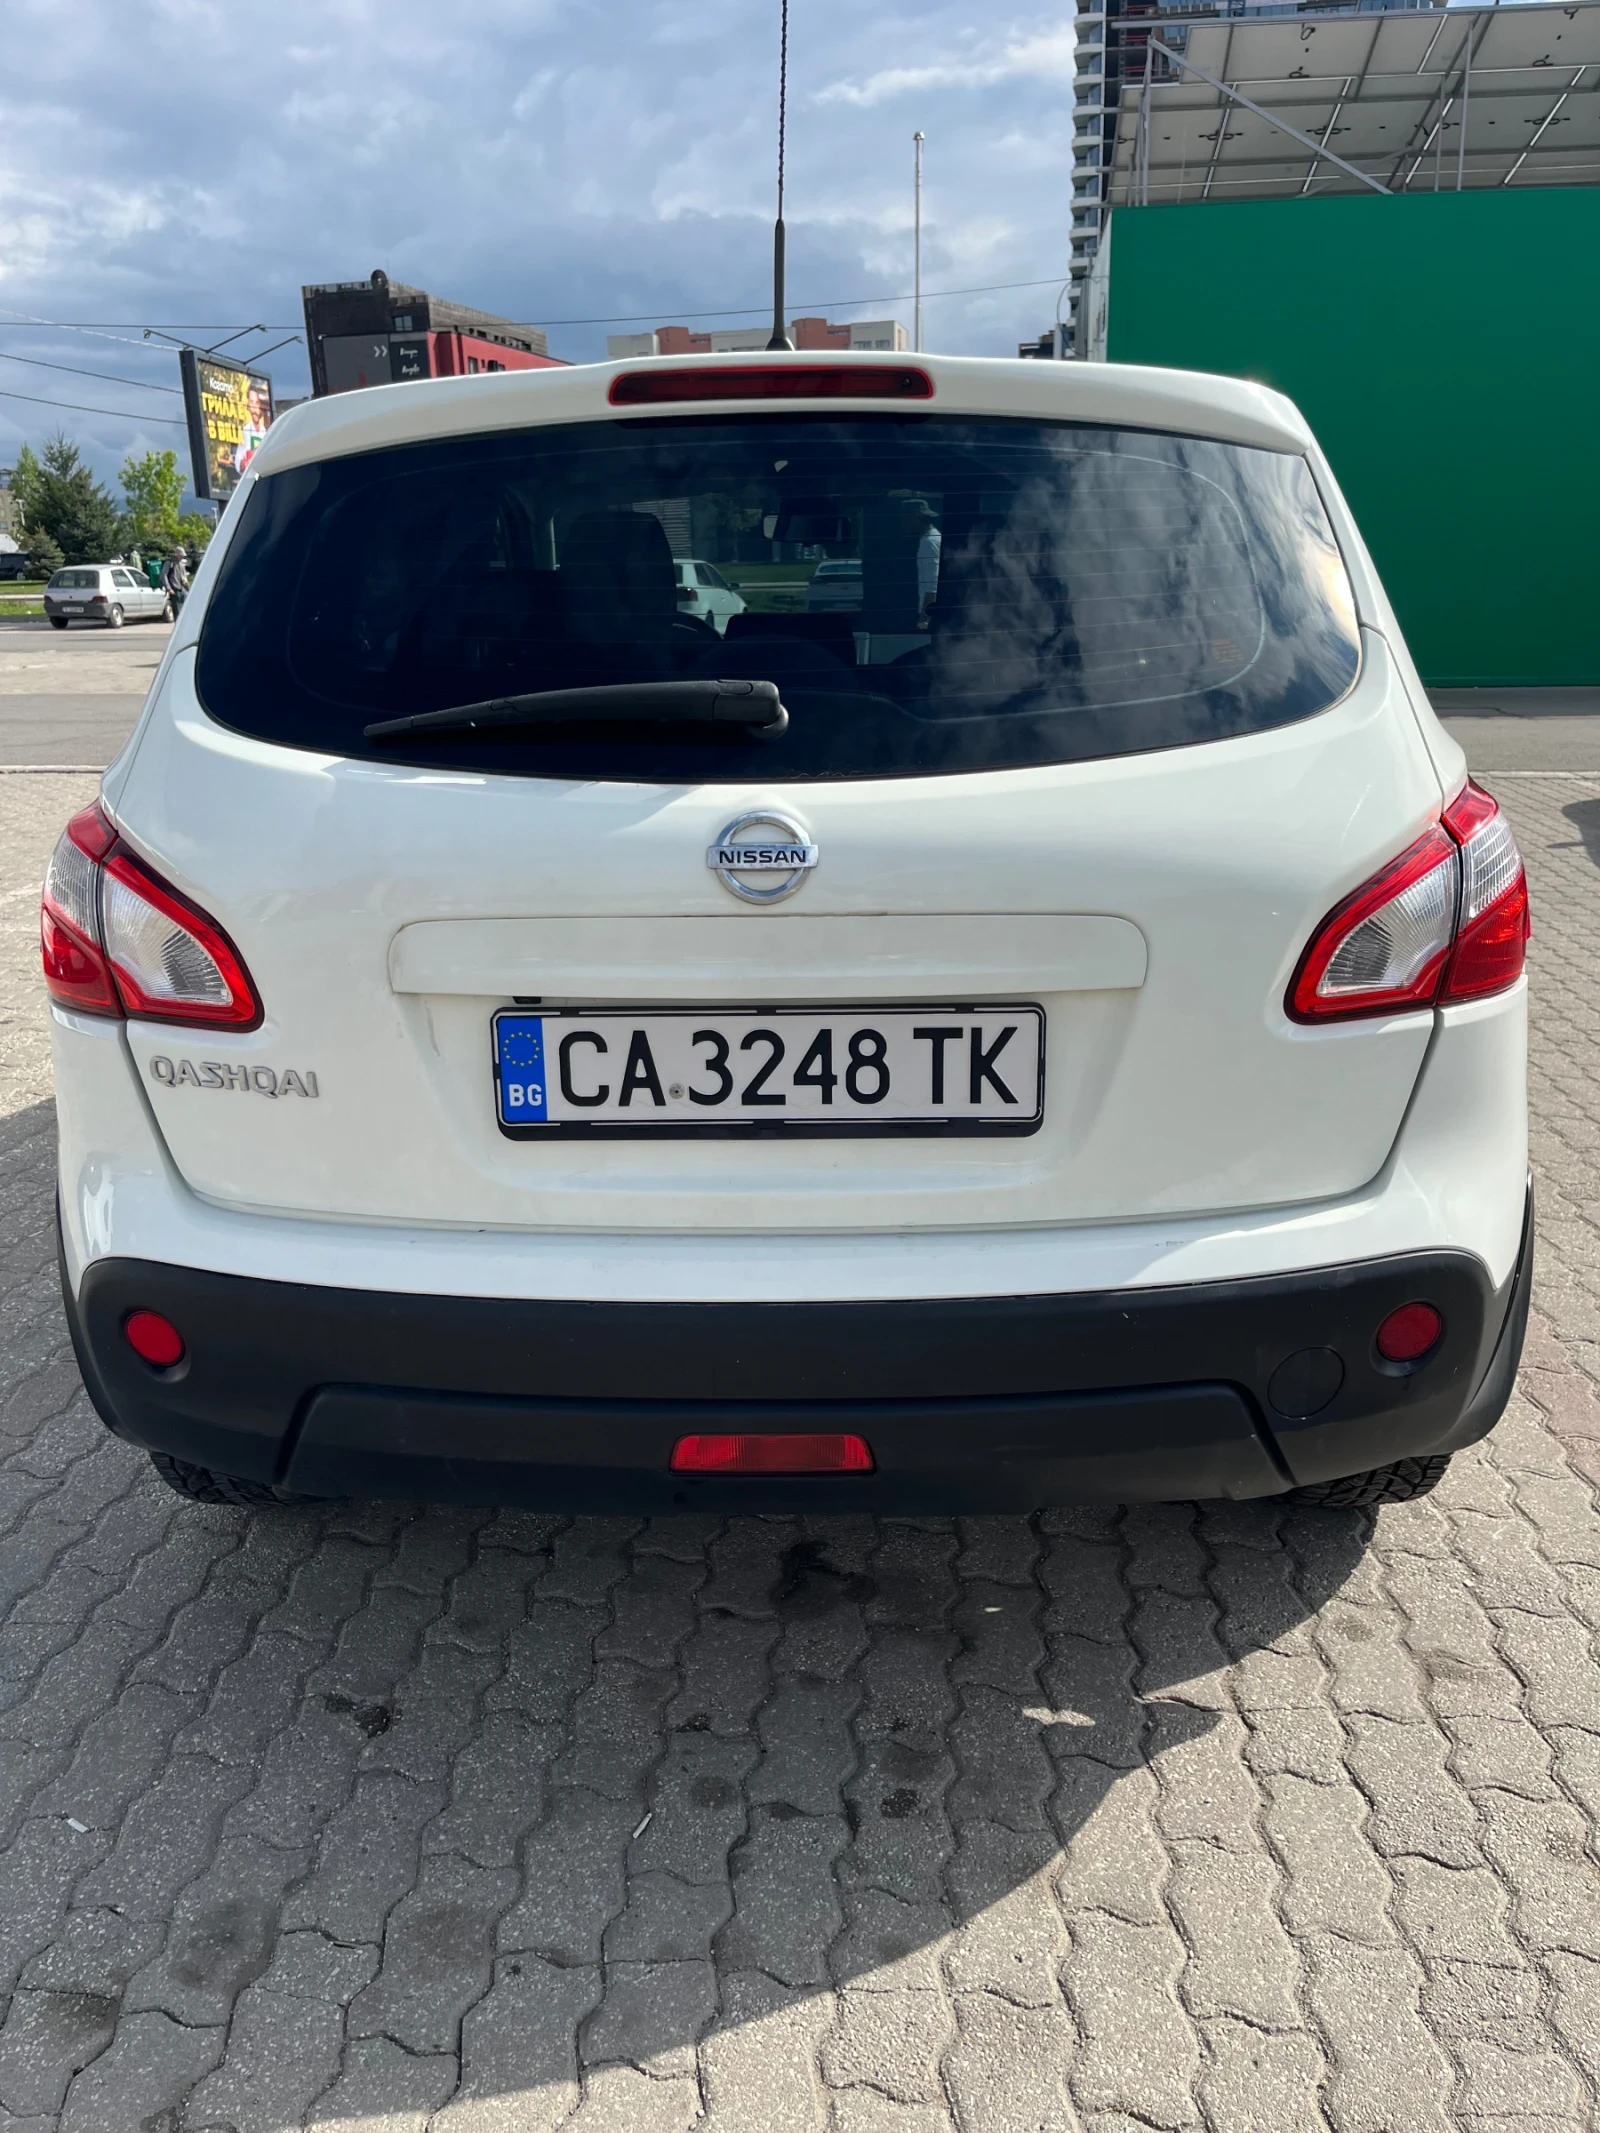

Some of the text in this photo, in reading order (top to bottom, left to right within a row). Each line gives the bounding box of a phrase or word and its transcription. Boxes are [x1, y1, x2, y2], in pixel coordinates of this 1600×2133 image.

[217, 420, 244, 445] BILLA
[719, 850, 806, 864] NISSAN
[149, 1055, 319, 1099] QASHQAI
[558, 1026, 1019, 1108] CA 3248 TK
[508, 1083, 542, 1107] BG
